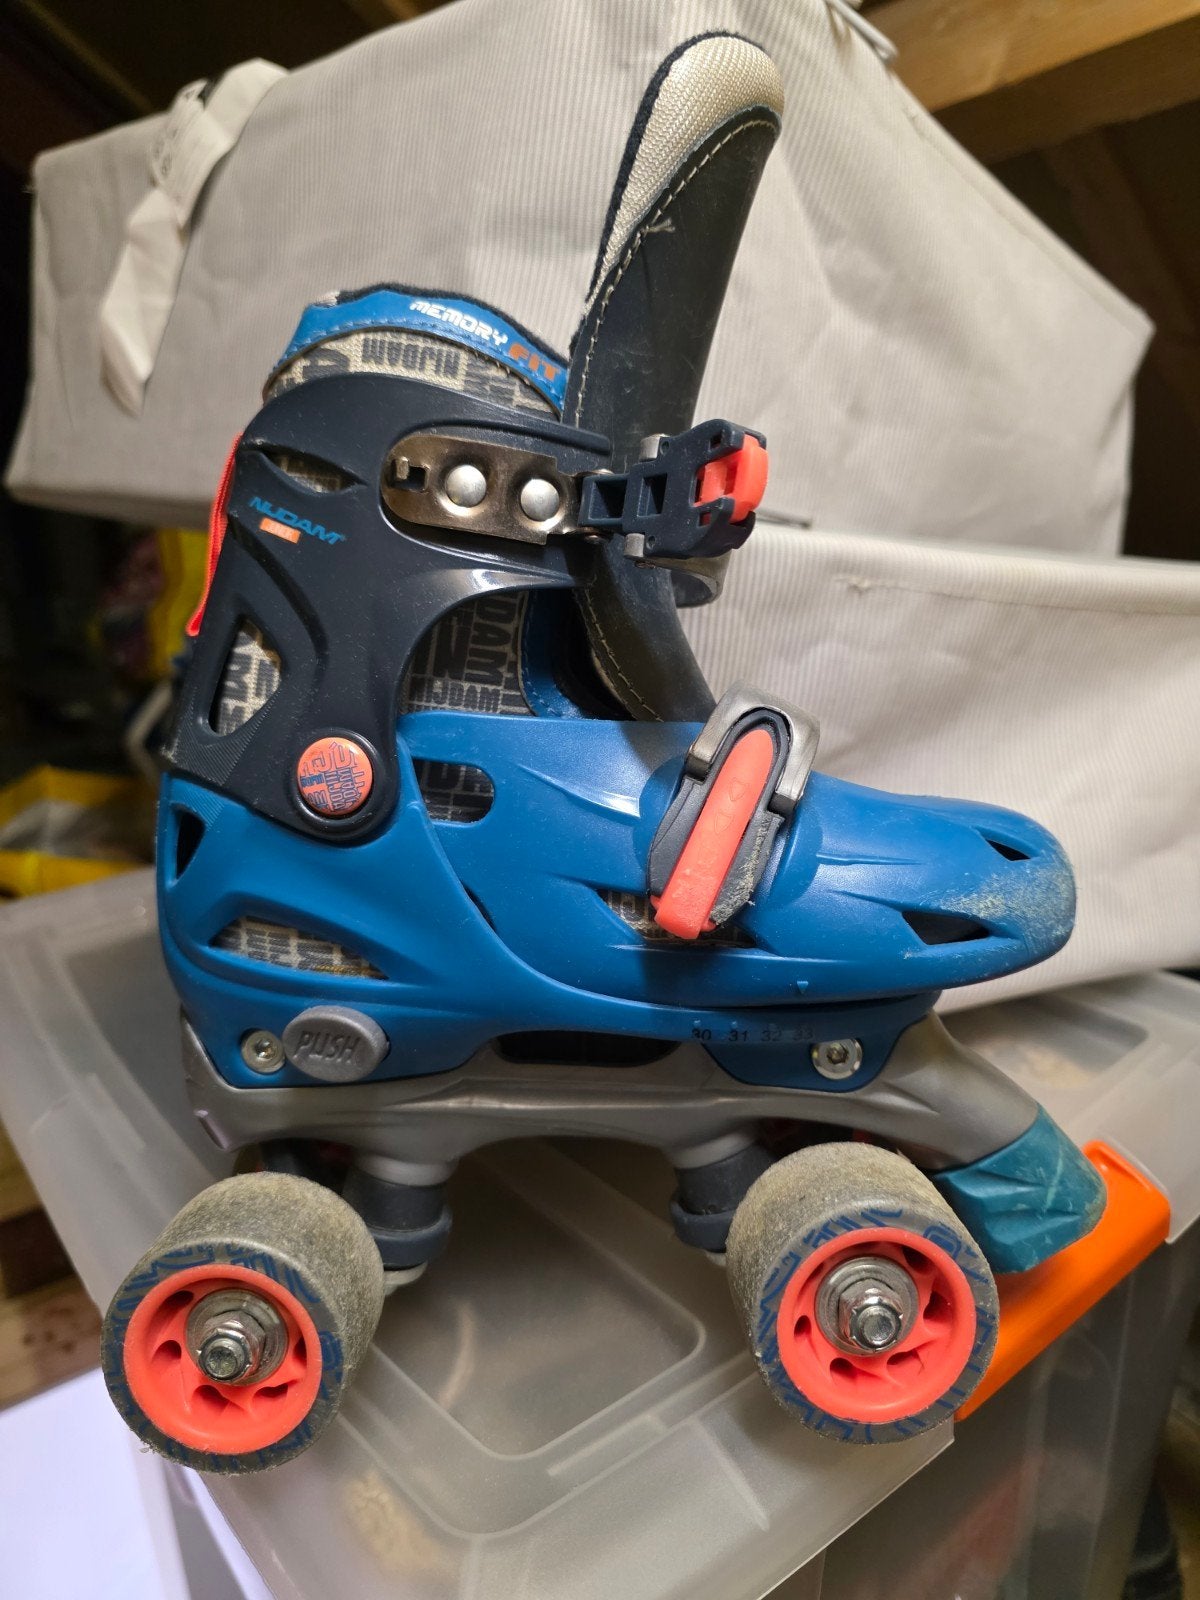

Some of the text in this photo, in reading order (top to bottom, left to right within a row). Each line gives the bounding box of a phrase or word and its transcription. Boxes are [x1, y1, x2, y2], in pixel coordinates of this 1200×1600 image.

[409, 301, 508, 346] MEMORY
[508, 342, 562, 381] FIT
[292, 1030, 361, 1062] PUSH
[691, 1028, 712, 1041] 30
[728, 1029, 749, 1042] 31
[761, 1029, 783, 1042] 32
